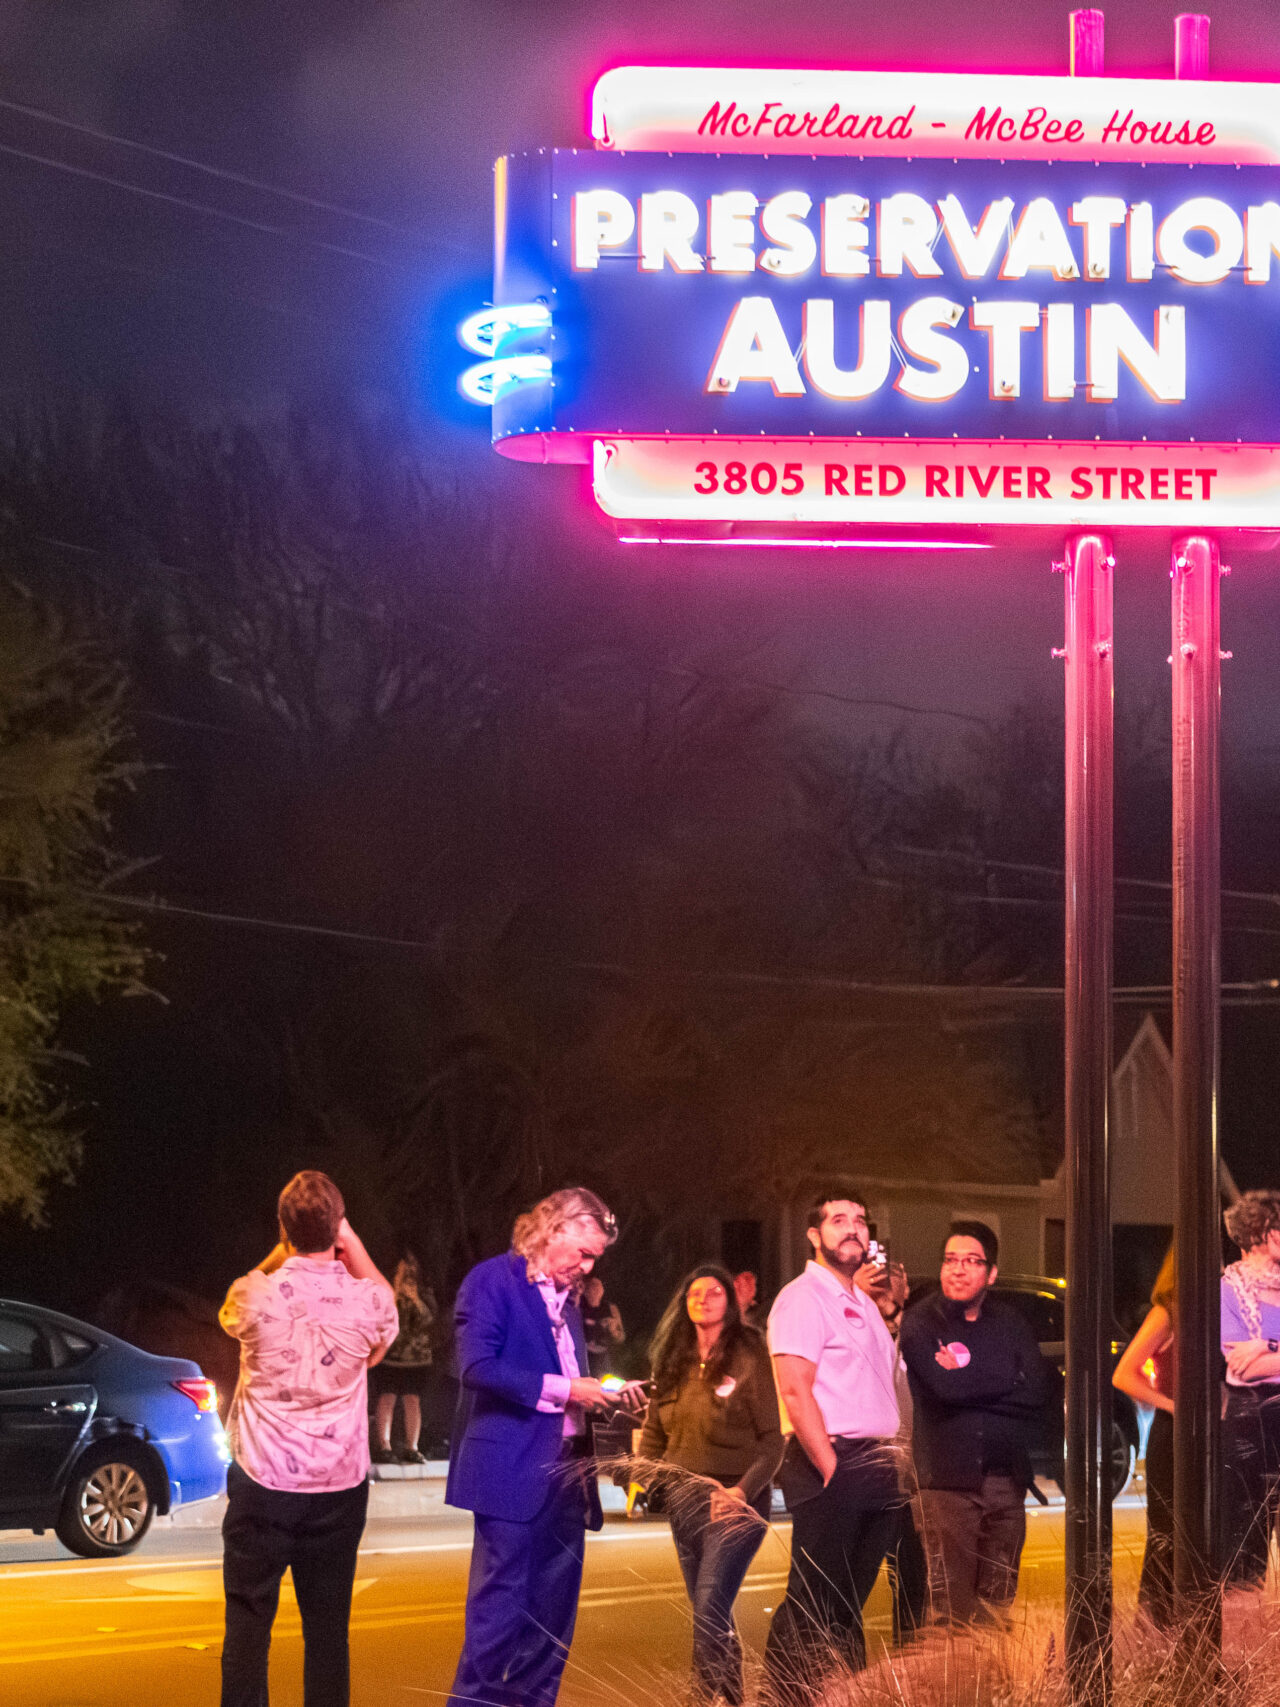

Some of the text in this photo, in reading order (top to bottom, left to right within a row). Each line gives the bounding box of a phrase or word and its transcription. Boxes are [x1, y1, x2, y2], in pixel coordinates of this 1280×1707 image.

[697, 101, 915, 139] McFarland
[964, 106, 1085, 142] McBee
[1101, 109, 1216, 145] House
[706, 297, 1186, 402] AUSTIN
[694, 461, 1217, 500] 3805 RED RIVER STREET
